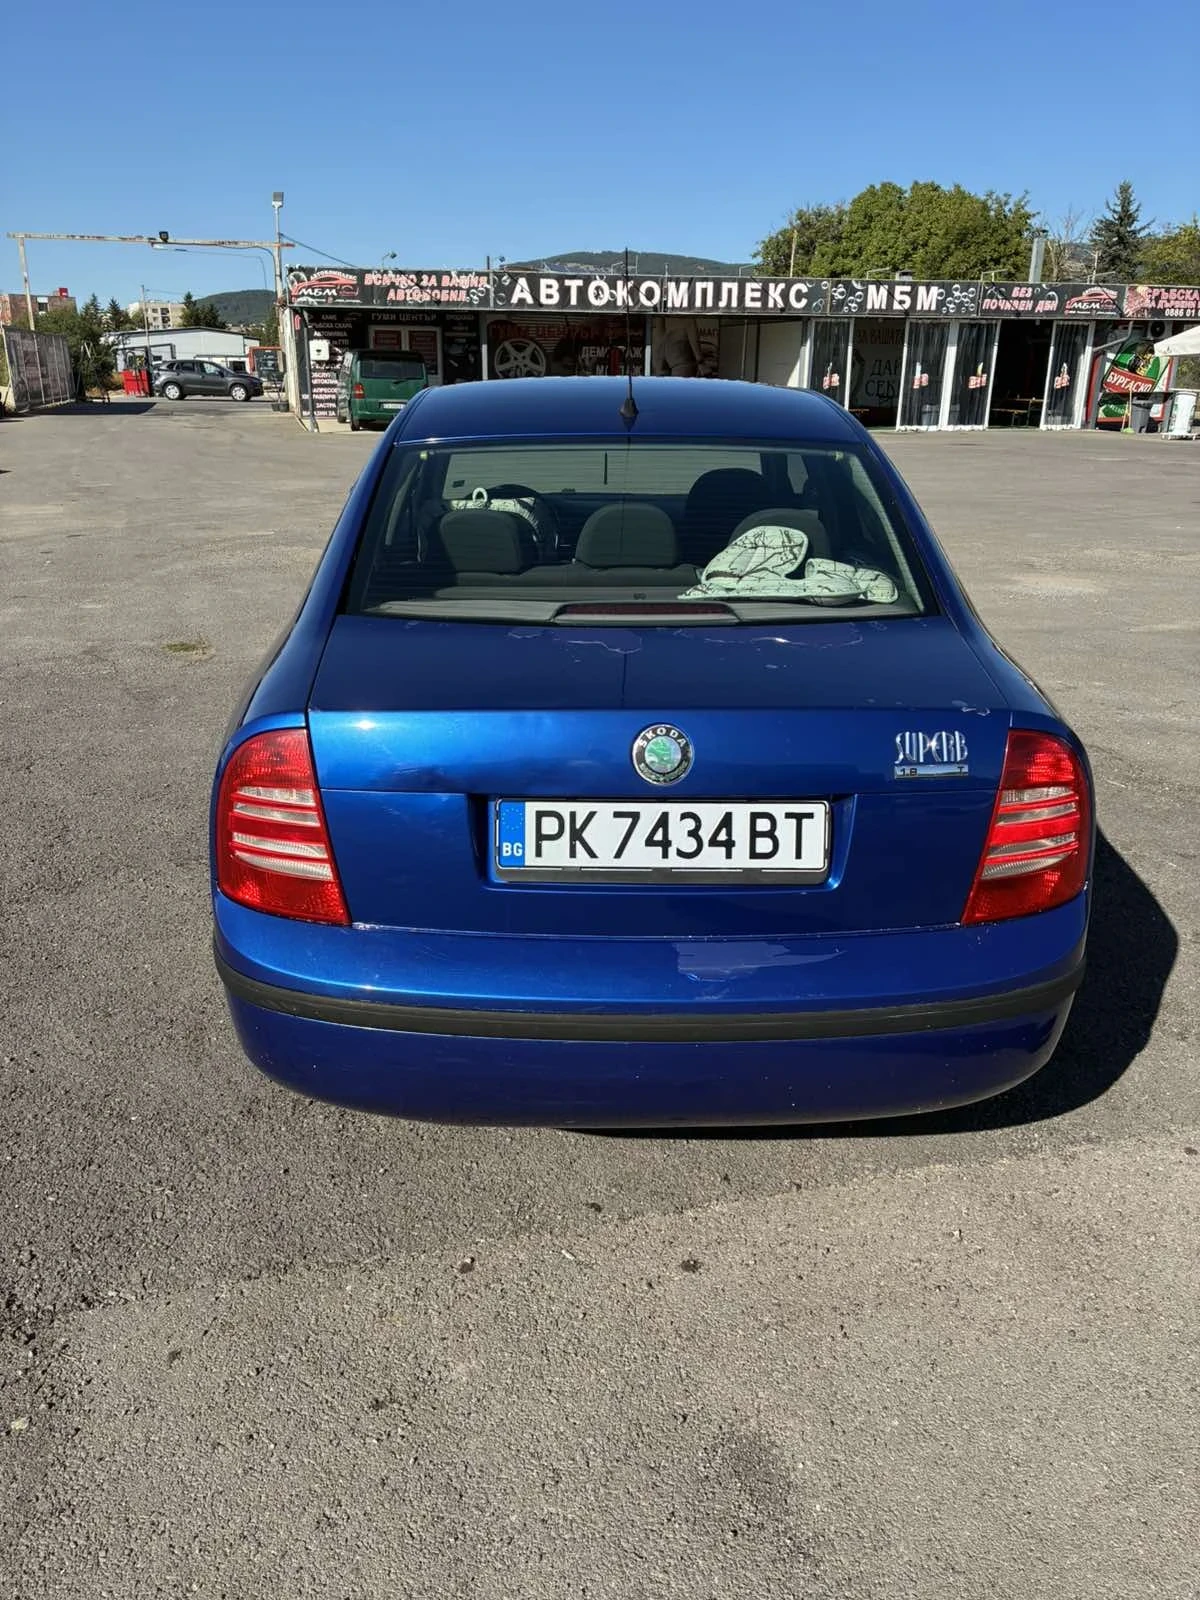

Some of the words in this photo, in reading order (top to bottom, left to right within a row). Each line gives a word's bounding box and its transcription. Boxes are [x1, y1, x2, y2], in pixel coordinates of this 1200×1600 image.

[421, 275, 437, 287] ЗА
[299, 288, 338, 296] МБМ
[510, 277, 808, 309] АВТОКОМПЛЕКС
[866, 284, 939, 311] МБМ
[1011, 286, 1033, 298] БЕЗ
[982, 298, 1034, 311] ПОЧИВЕН
[371, 312, 396, 321] ГУМИ
[1106, 371, 1153, 393] БУРГАСКО
[638, 727, 687, 749] SKODA
[894, 731, 969, 764] SUPERB
[534, 810, 598, 859] PK
[612, 811, 736, 860] 7434
[748, 811, 815, 860] BT
[502, 842, 523, 857] BG
